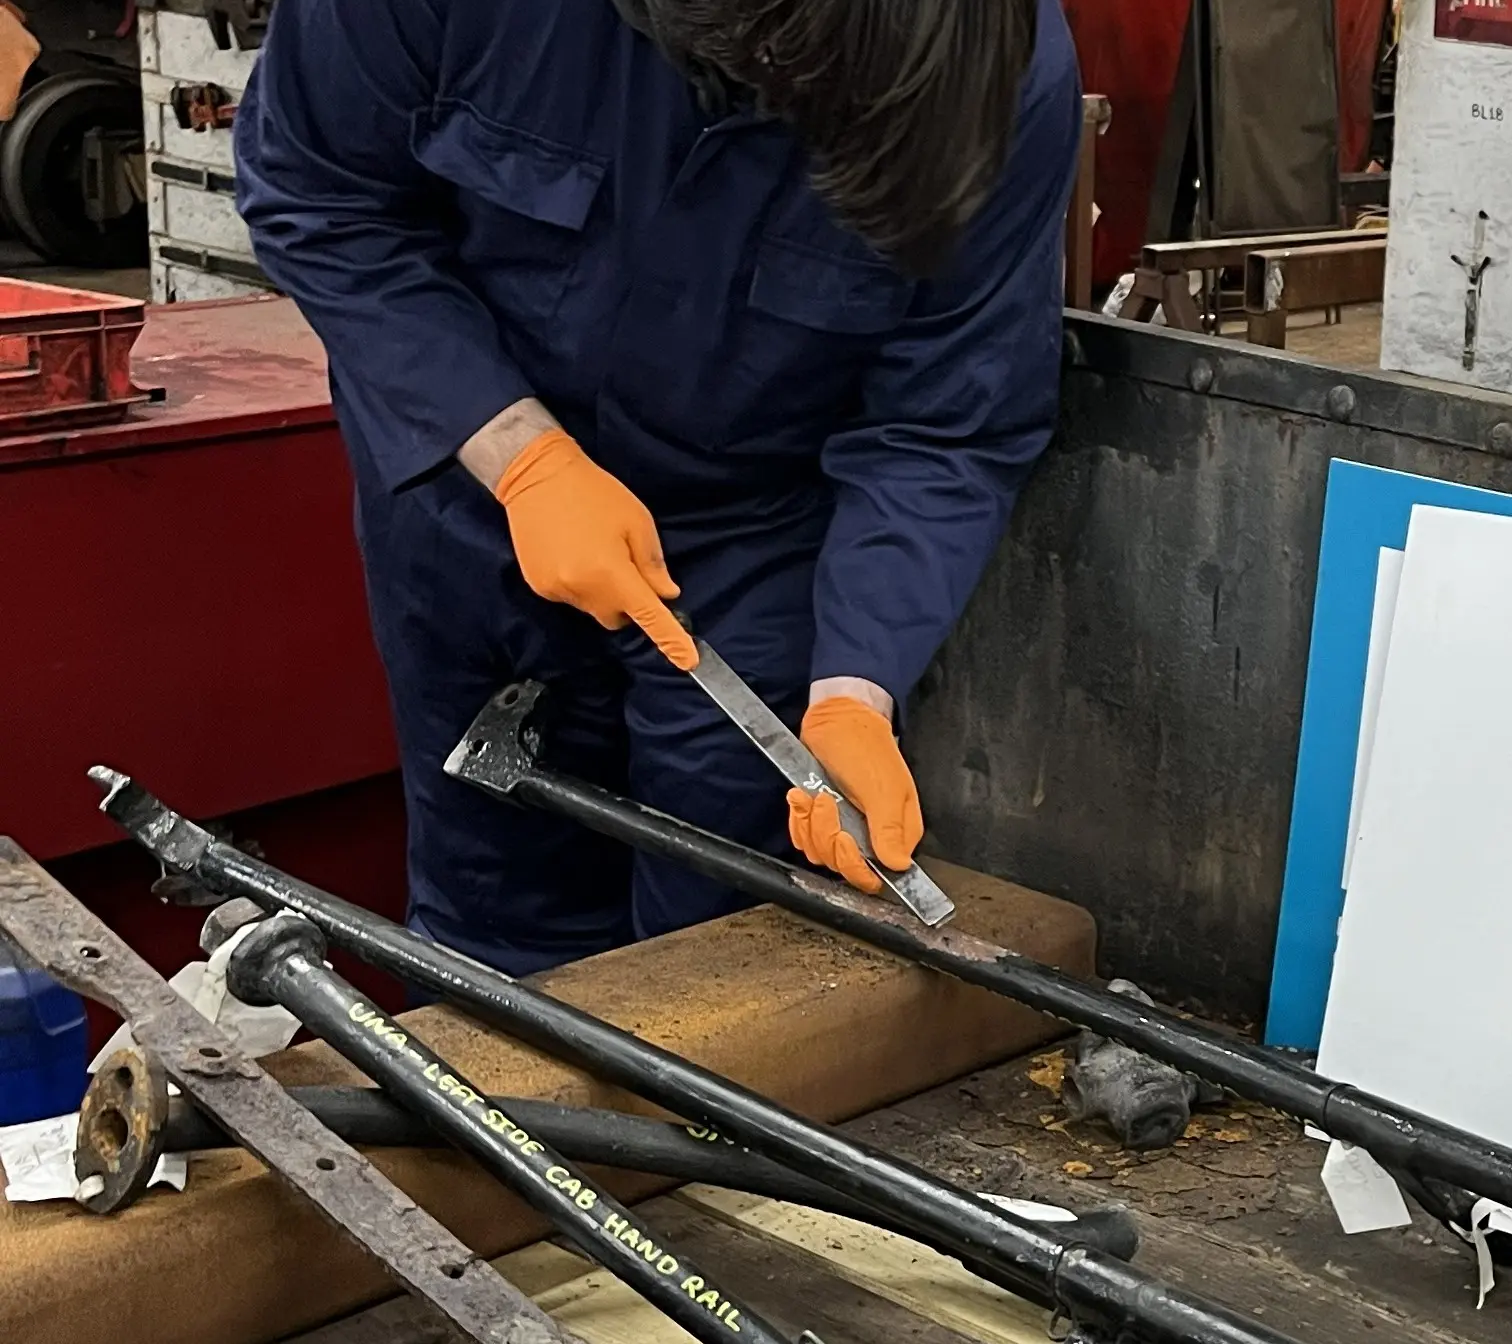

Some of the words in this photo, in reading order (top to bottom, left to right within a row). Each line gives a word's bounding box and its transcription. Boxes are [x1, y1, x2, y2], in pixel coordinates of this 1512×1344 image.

[423, 1063, 485, 1106] LEFT
[481, 1109, 545, 1156] SIDE
[546, 1165, 597, 1211] CAB
[604, 1213, 680, 1275] HAND
[680, 1275, 741, 1333] RAIL
